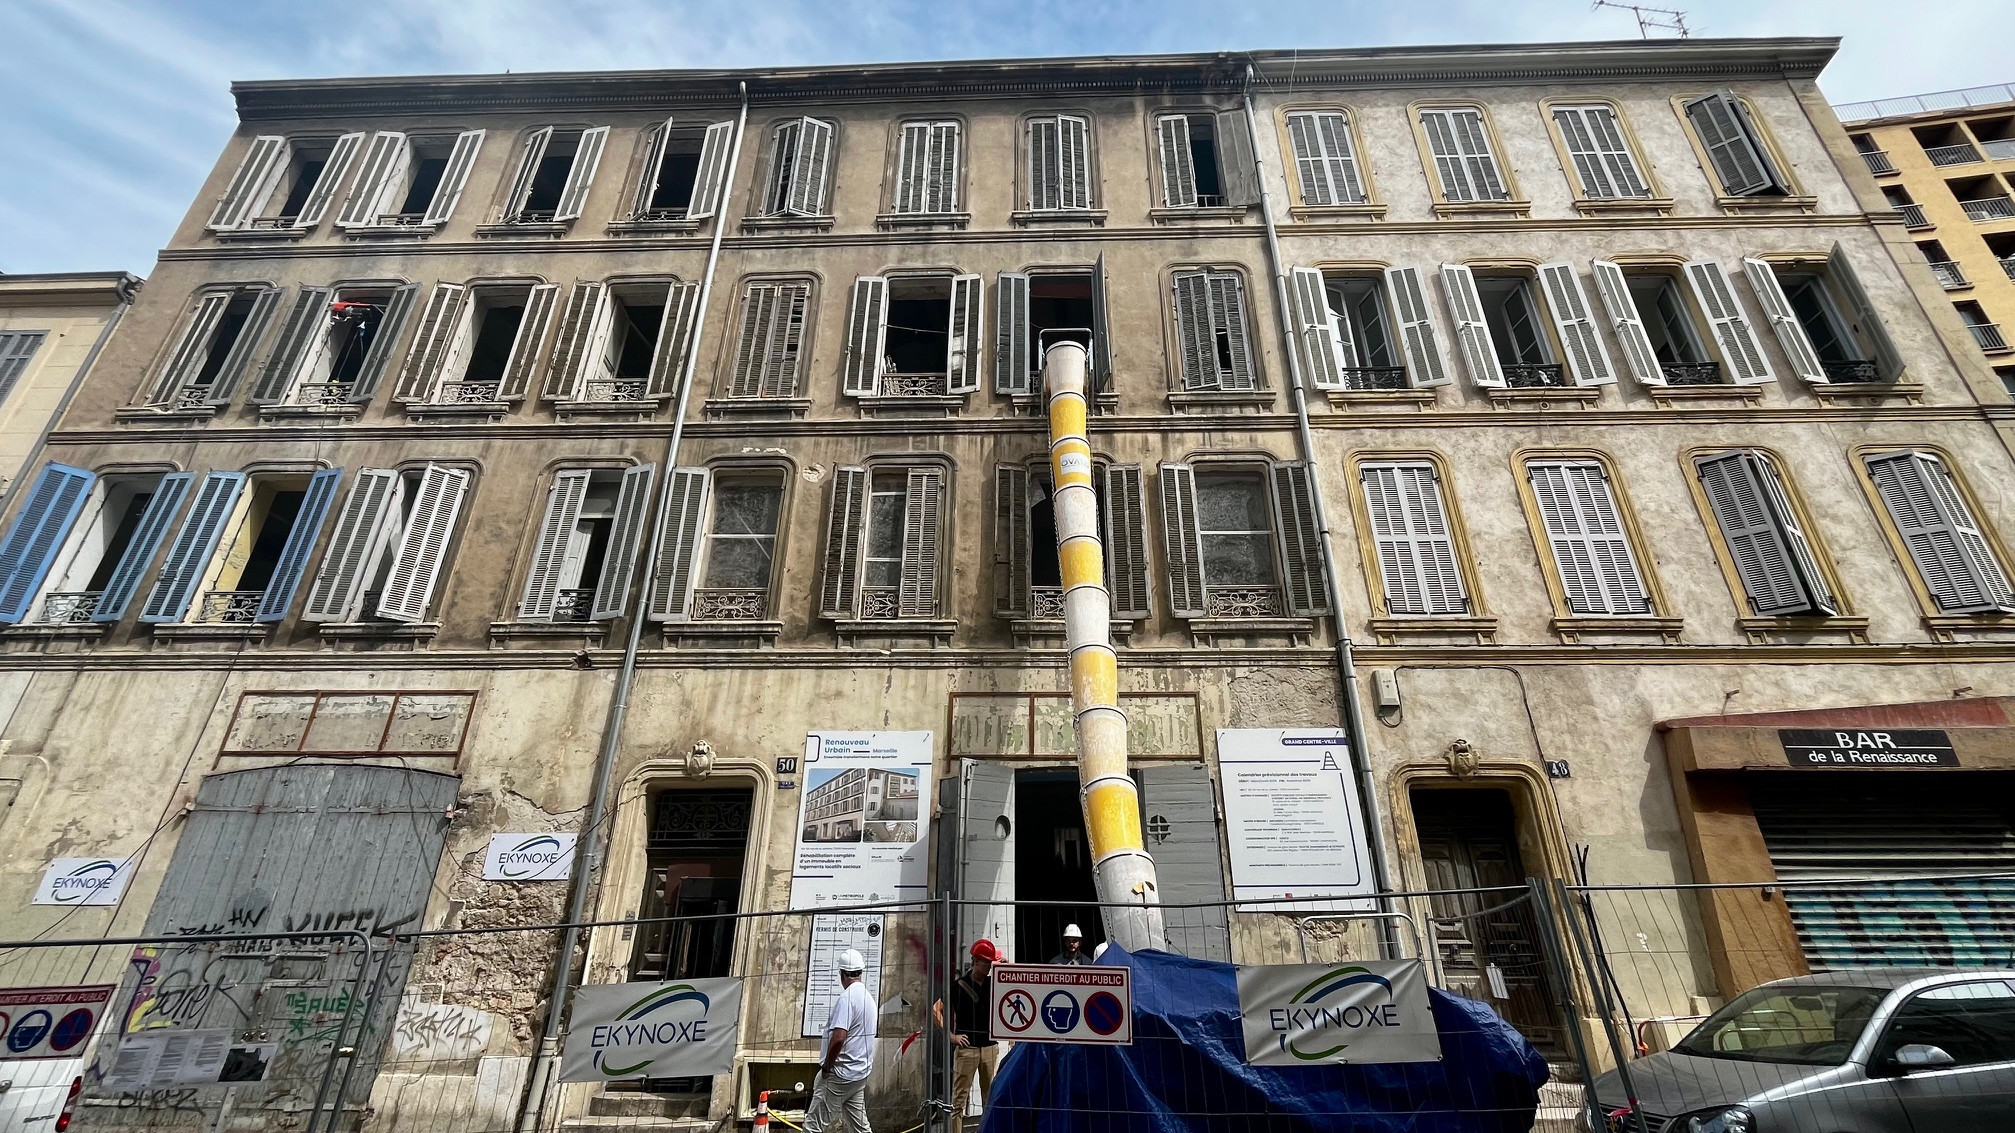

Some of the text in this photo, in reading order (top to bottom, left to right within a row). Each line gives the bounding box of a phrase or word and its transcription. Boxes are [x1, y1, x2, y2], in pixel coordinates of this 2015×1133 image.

[1834, 732, 1898, 749] BAR
[1808, 750, 1938, 763] de la Renaissance
[778, 758, 795, 772] 50
[1551, 762, 1568, 776] 48
[498, 852, 559, 864] EKYNOXE
[52, 877, 113, 889] EKYNOXE
[999, 972, 1122, 985] CHANTIER INTERDIT AU PUBLIC
[28, 993, 66, 1003] INTERDIT
[66, 993, 78, 1002] AU
[79, 992, 106, 1001] PUBLIC
[1269, 1003, 1401, 1031] EKYNOXE
[590, 1020, 708, 1048] EKYNOXE
